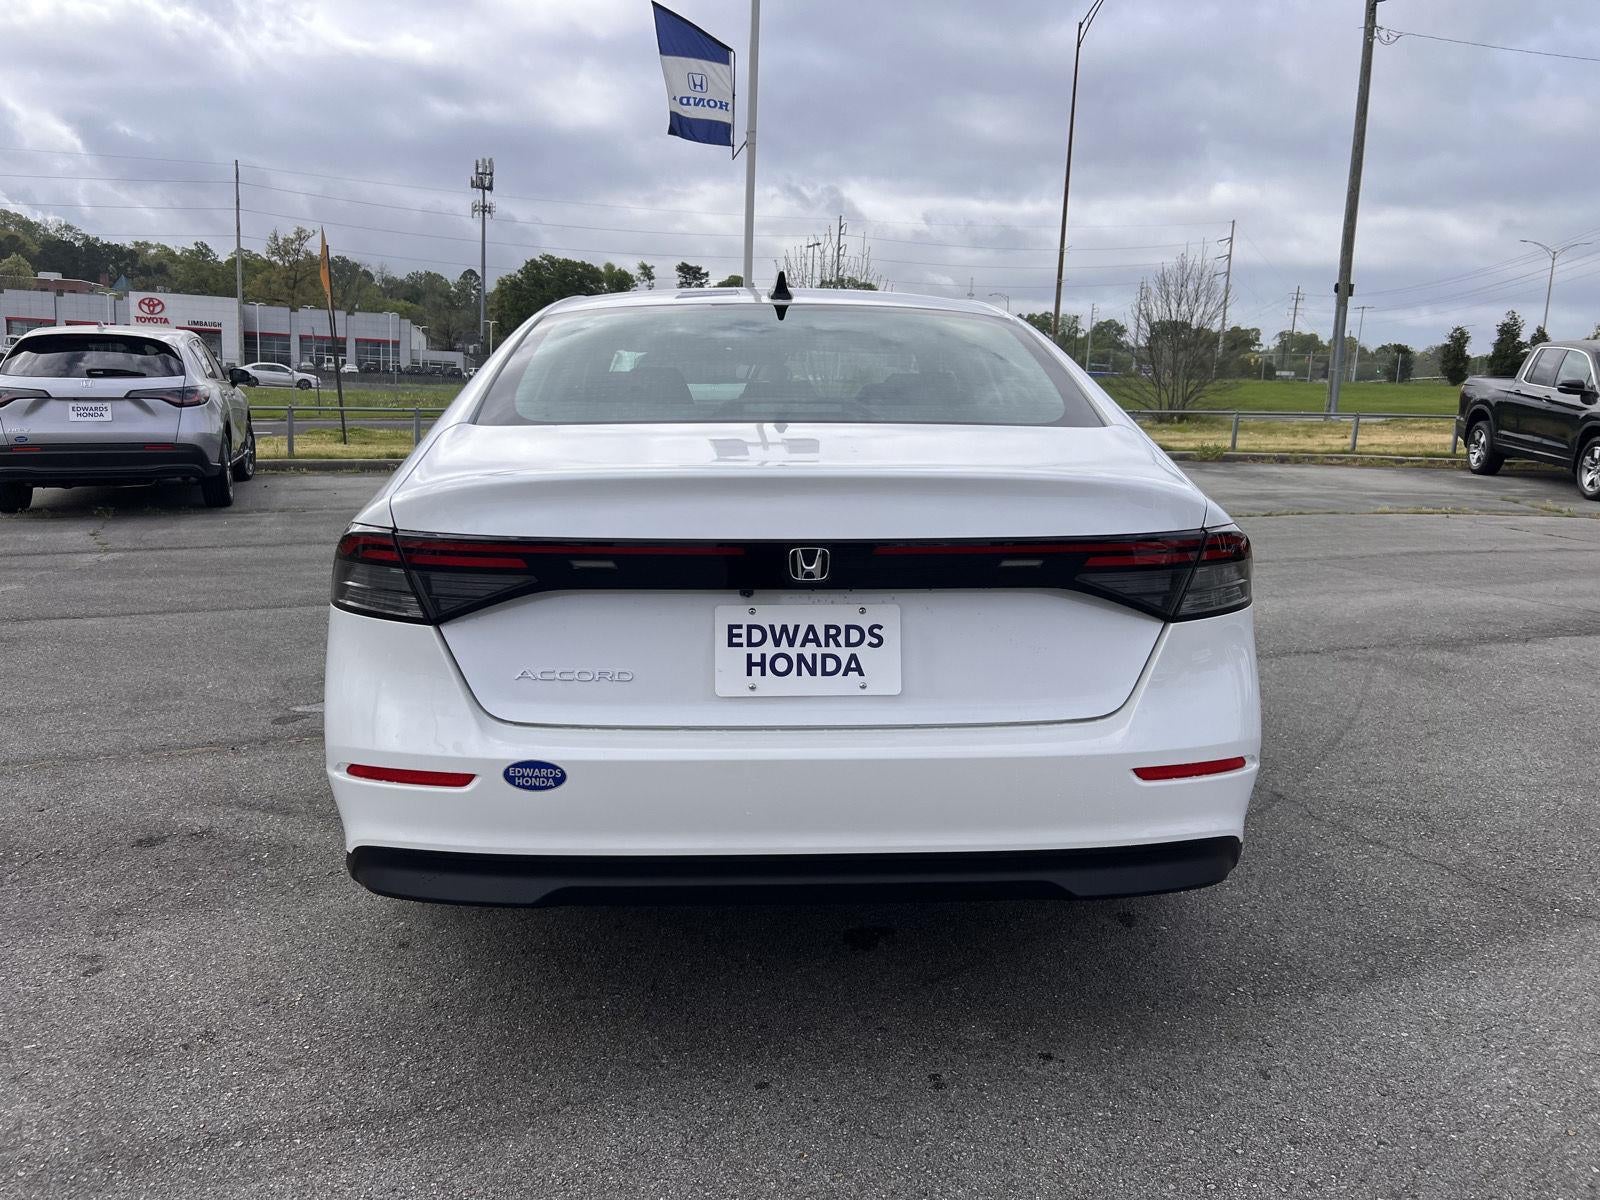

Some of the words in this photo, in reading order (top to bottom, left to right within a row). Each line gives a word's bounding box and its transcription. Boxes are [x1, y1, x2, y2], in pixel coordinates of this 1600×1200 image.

[134, 315, 170, 325] TOYOTA
[187, 319, 222, 328] LIMBAUGH
[727, 623, 884, 648] EDWARDS
[746, 652, 865, 677] HONDA
[514, 669, 634, 682] ACCORD
[509, 767, 562, 778] EDWARDS
[515, 777, 555, 787] HONDA
